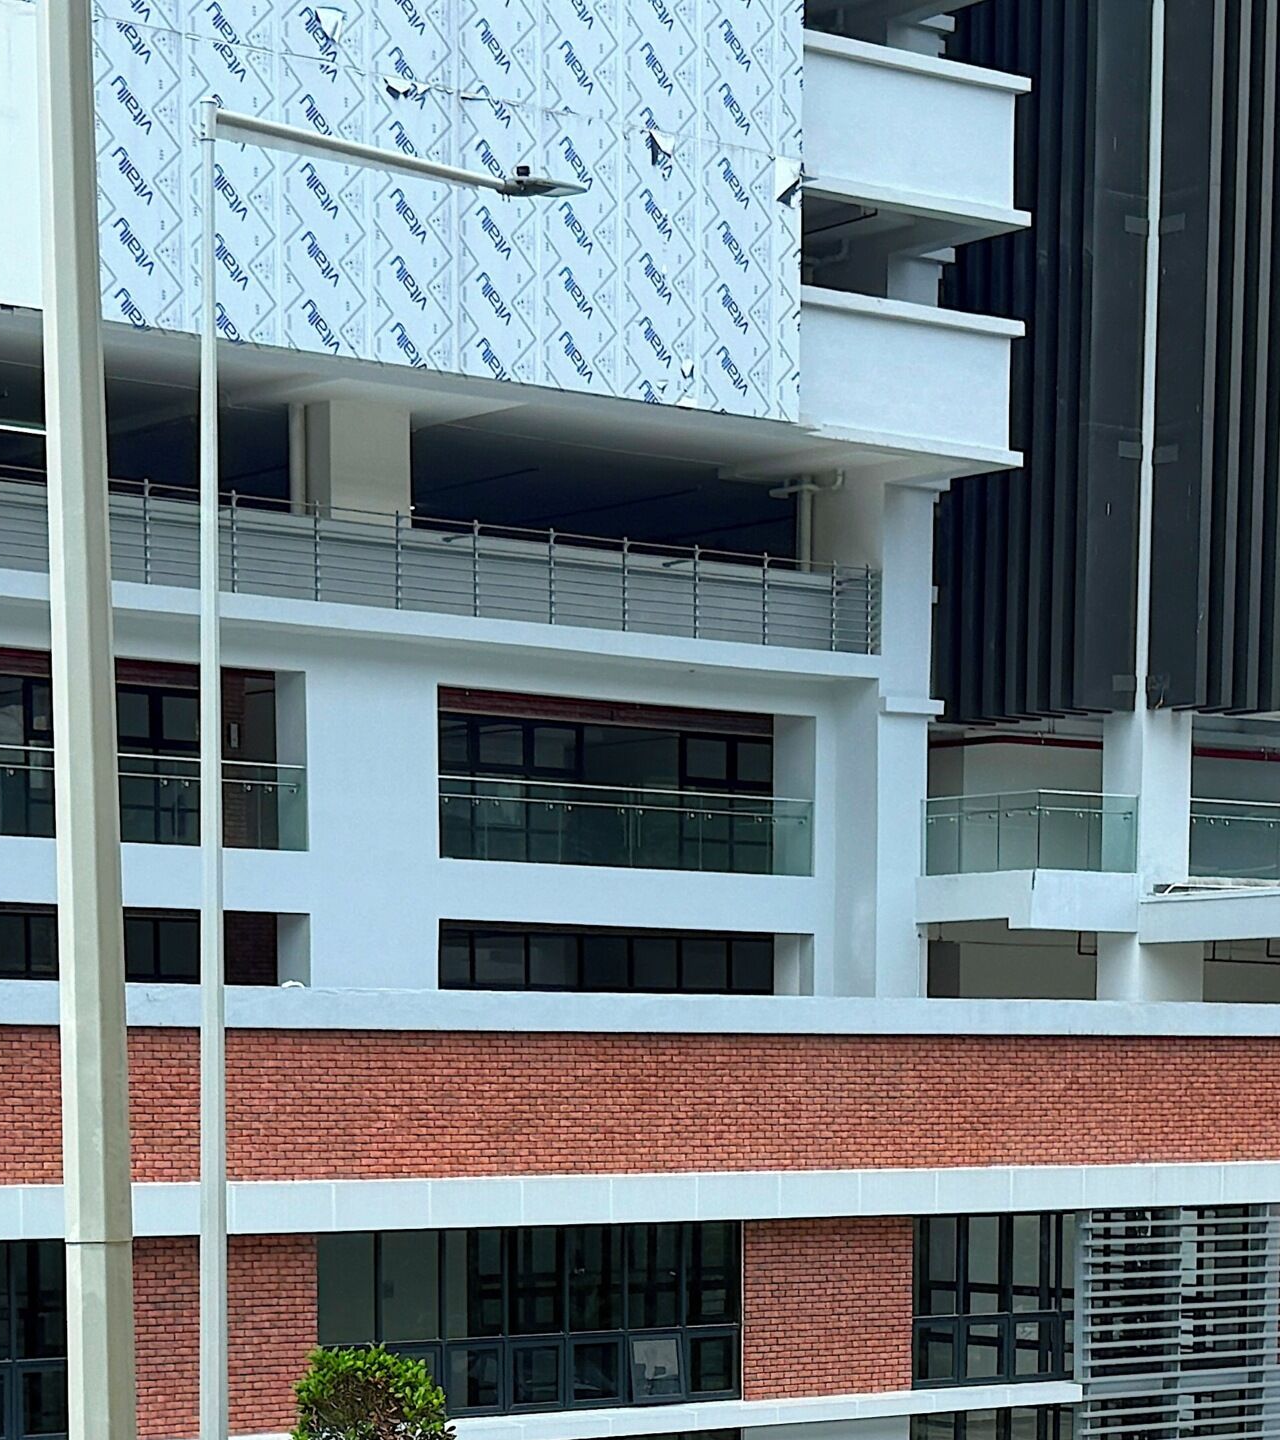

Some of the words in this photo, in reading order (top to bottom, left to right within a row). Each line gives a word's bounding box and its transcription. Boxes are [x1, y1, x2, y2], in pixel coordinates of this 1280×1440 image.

[475, 18, 510, 74] vitally
[559, 41, 593, 95] vitally
[640, 42, 673, 96] vitally
[719, 19, 751, 72] vitally
[111, 76, 152, 135] vitally
[719, 83, 750, 135] vitally
[112, 147, 153, 205] vitally
[300, 163, 338, 219] vitally
[718, 158, 749, 209] vitally
[390, 188, 426, 244] vitally
[476, 206, 511, 260] vitally
[559, 202, 593, 255] vitally
[112, 218, 154, 275] vitally
[301, 231, 339, 287] vitally
[717, 221, 749, 272] vitally
[390, 256, 426, 312] vitally
[476, 272, 511, 325] vitally
[559, 267, 593, 319] vitally
[639, 253, 671, 305] vitally
[302, 299, 340, 352] vitally
[717, 284, 748, 335] vitally
[559, 331, 592, 384] vitally
[639, 317, 671, 368] vitally
[716, 346, 747, 396] vitally
